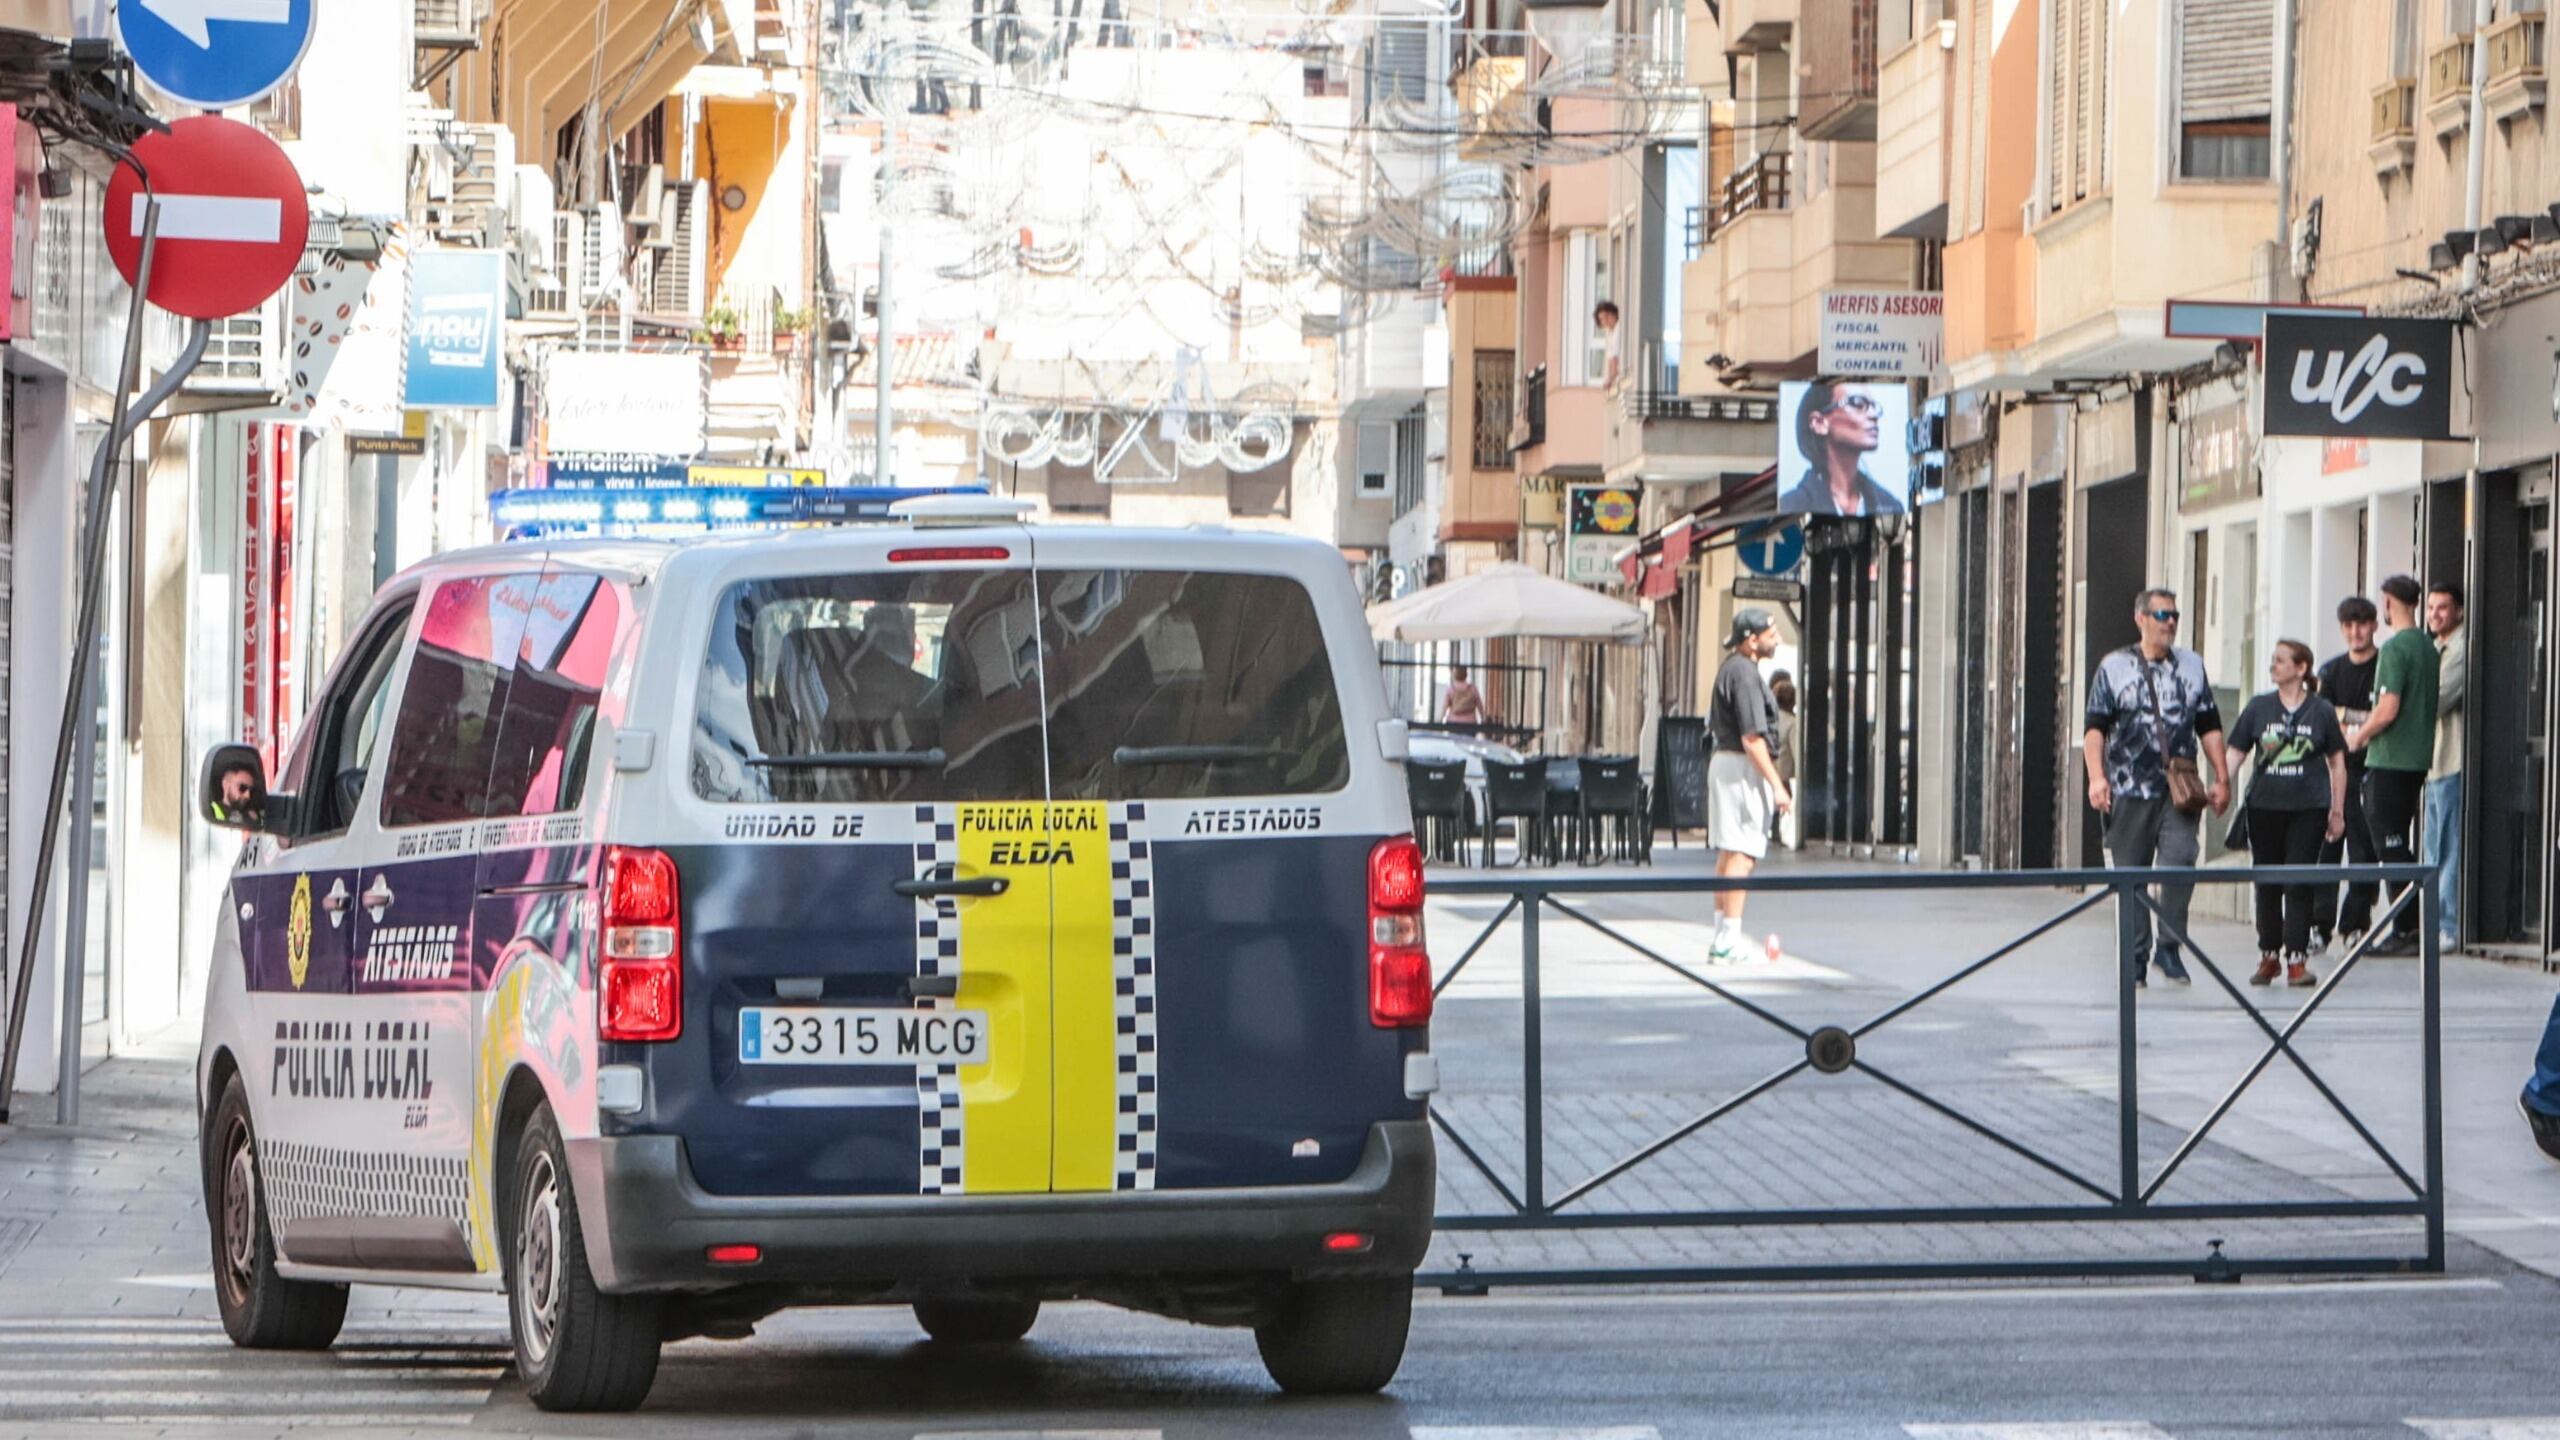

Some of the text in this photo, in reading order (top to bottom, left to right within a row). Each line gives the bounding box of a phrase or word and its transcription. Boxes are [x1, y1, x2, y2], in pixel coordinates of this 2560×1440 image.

[1827, 295, 1879, 314] MERFIS
[1835, 322, 1879, 334] FISCAL
[420, 335, 481, 349] FOTO
[1835, 341, 1908, 353] MERCANTIL
[1835, 359, 1903, 371] CONTABLE
[357, 440, 389, 449] Punto
[725, 814, 864, 837] UNIDAD DE
[962, 807, 1098, 832] POLICIA LOCAL
[1184, 806, 1322, 834] ATESTADOS
[989, 841, 1075, 865] ELDA
[362, 925, 458, 983] ATESTADOS
[772, 1016, 977, 1056] 3315 MCG
[271, 1021, 433, 1100] POLICIA LOCAL
